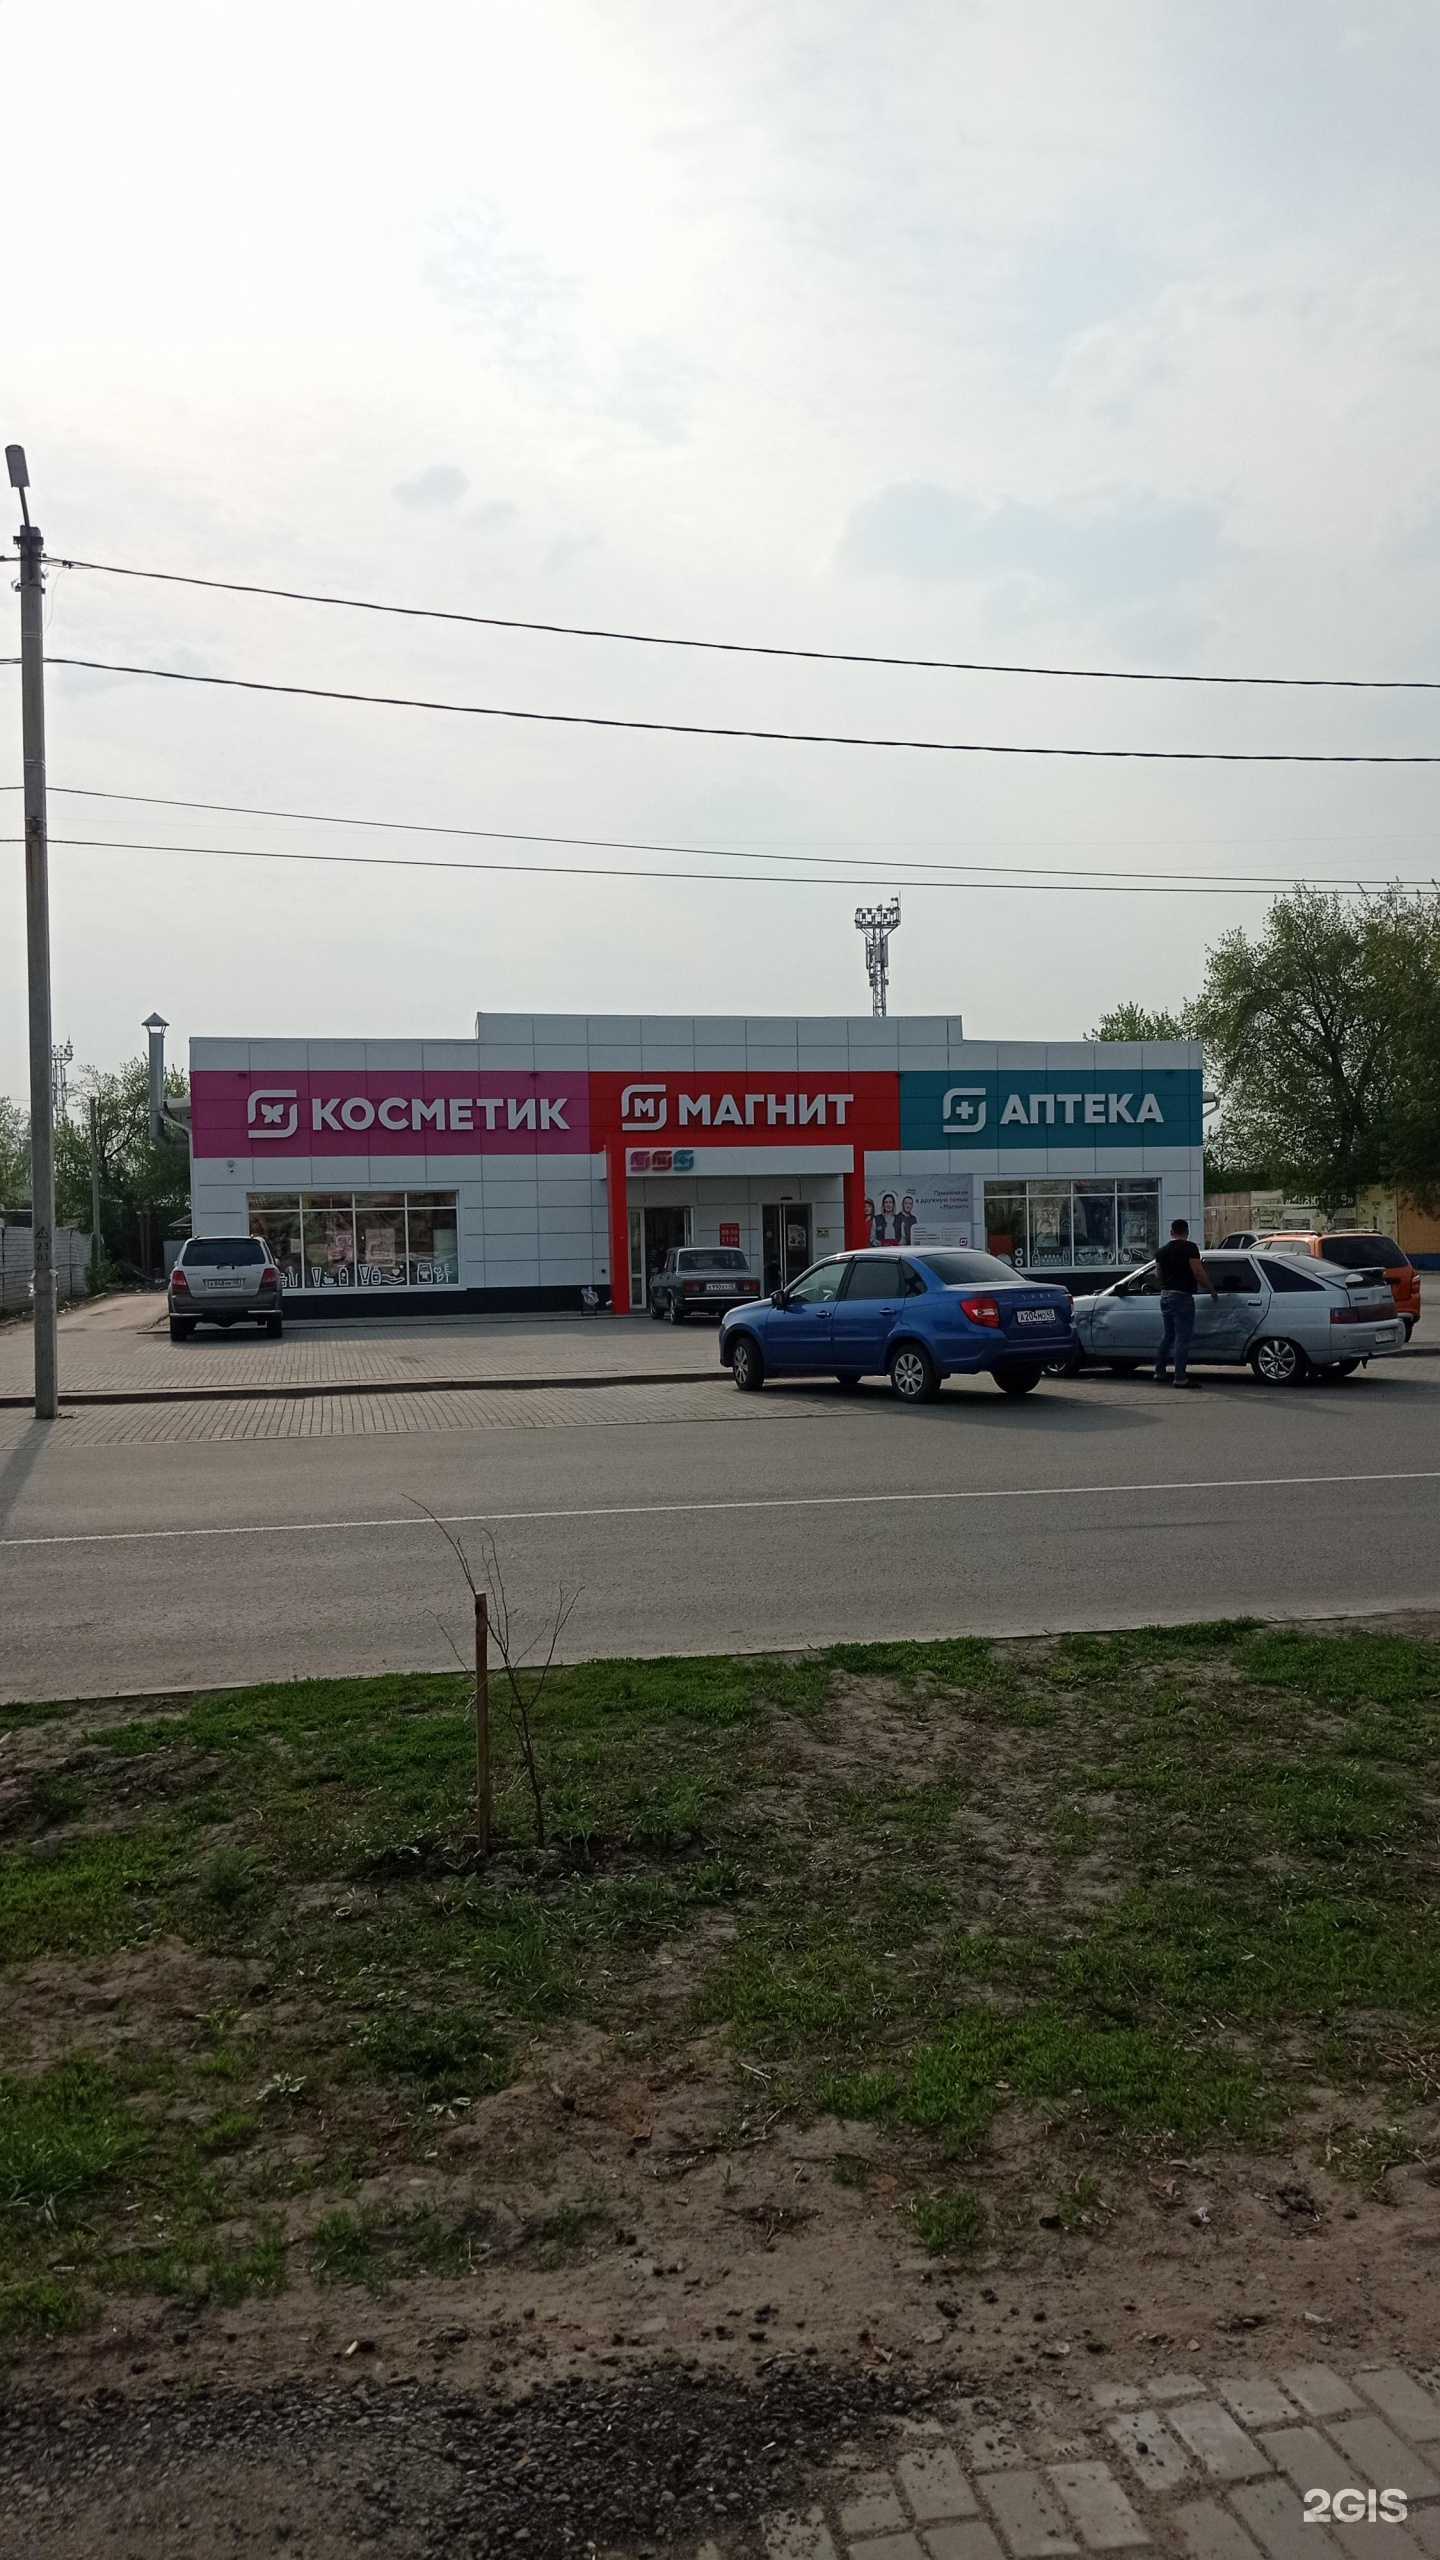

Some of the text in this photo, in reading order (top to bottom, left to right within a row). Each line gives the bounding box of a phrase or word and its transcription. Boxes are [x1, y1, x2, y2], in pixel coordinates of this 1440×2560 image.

[312, 1097, 570, 1131] КОСМЕТИК
[678, 1094, 854, 1126] МАГНИТ
[1000, 1093, 1164, 1125] АПТЕКА
